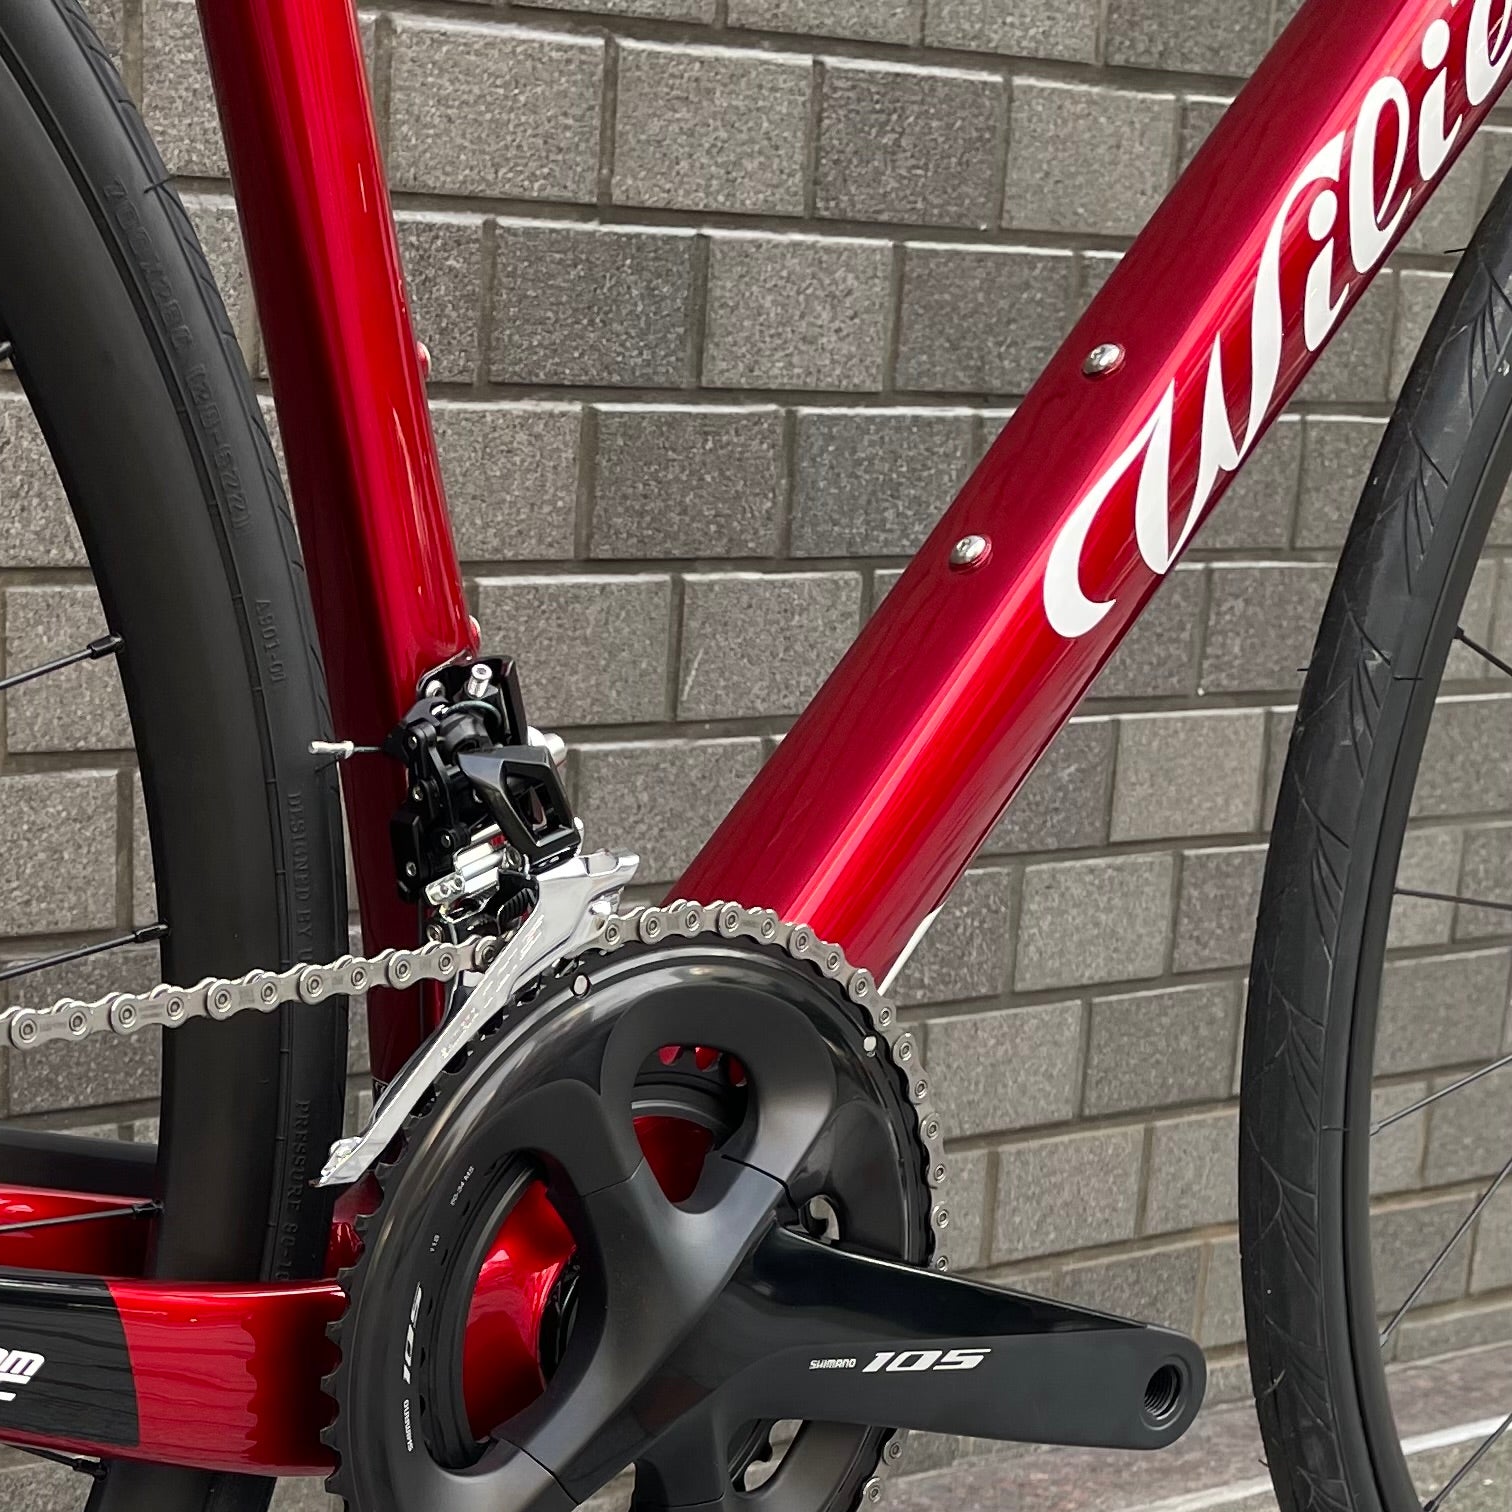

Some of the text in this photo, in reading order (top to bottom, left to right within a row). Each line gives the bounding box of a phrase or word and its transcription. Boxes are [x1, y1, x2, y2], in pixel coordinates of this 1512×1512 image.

[403, 1282, 423, 1384] 105
[808, 1348, 992, 1373] SHIMANO 105
